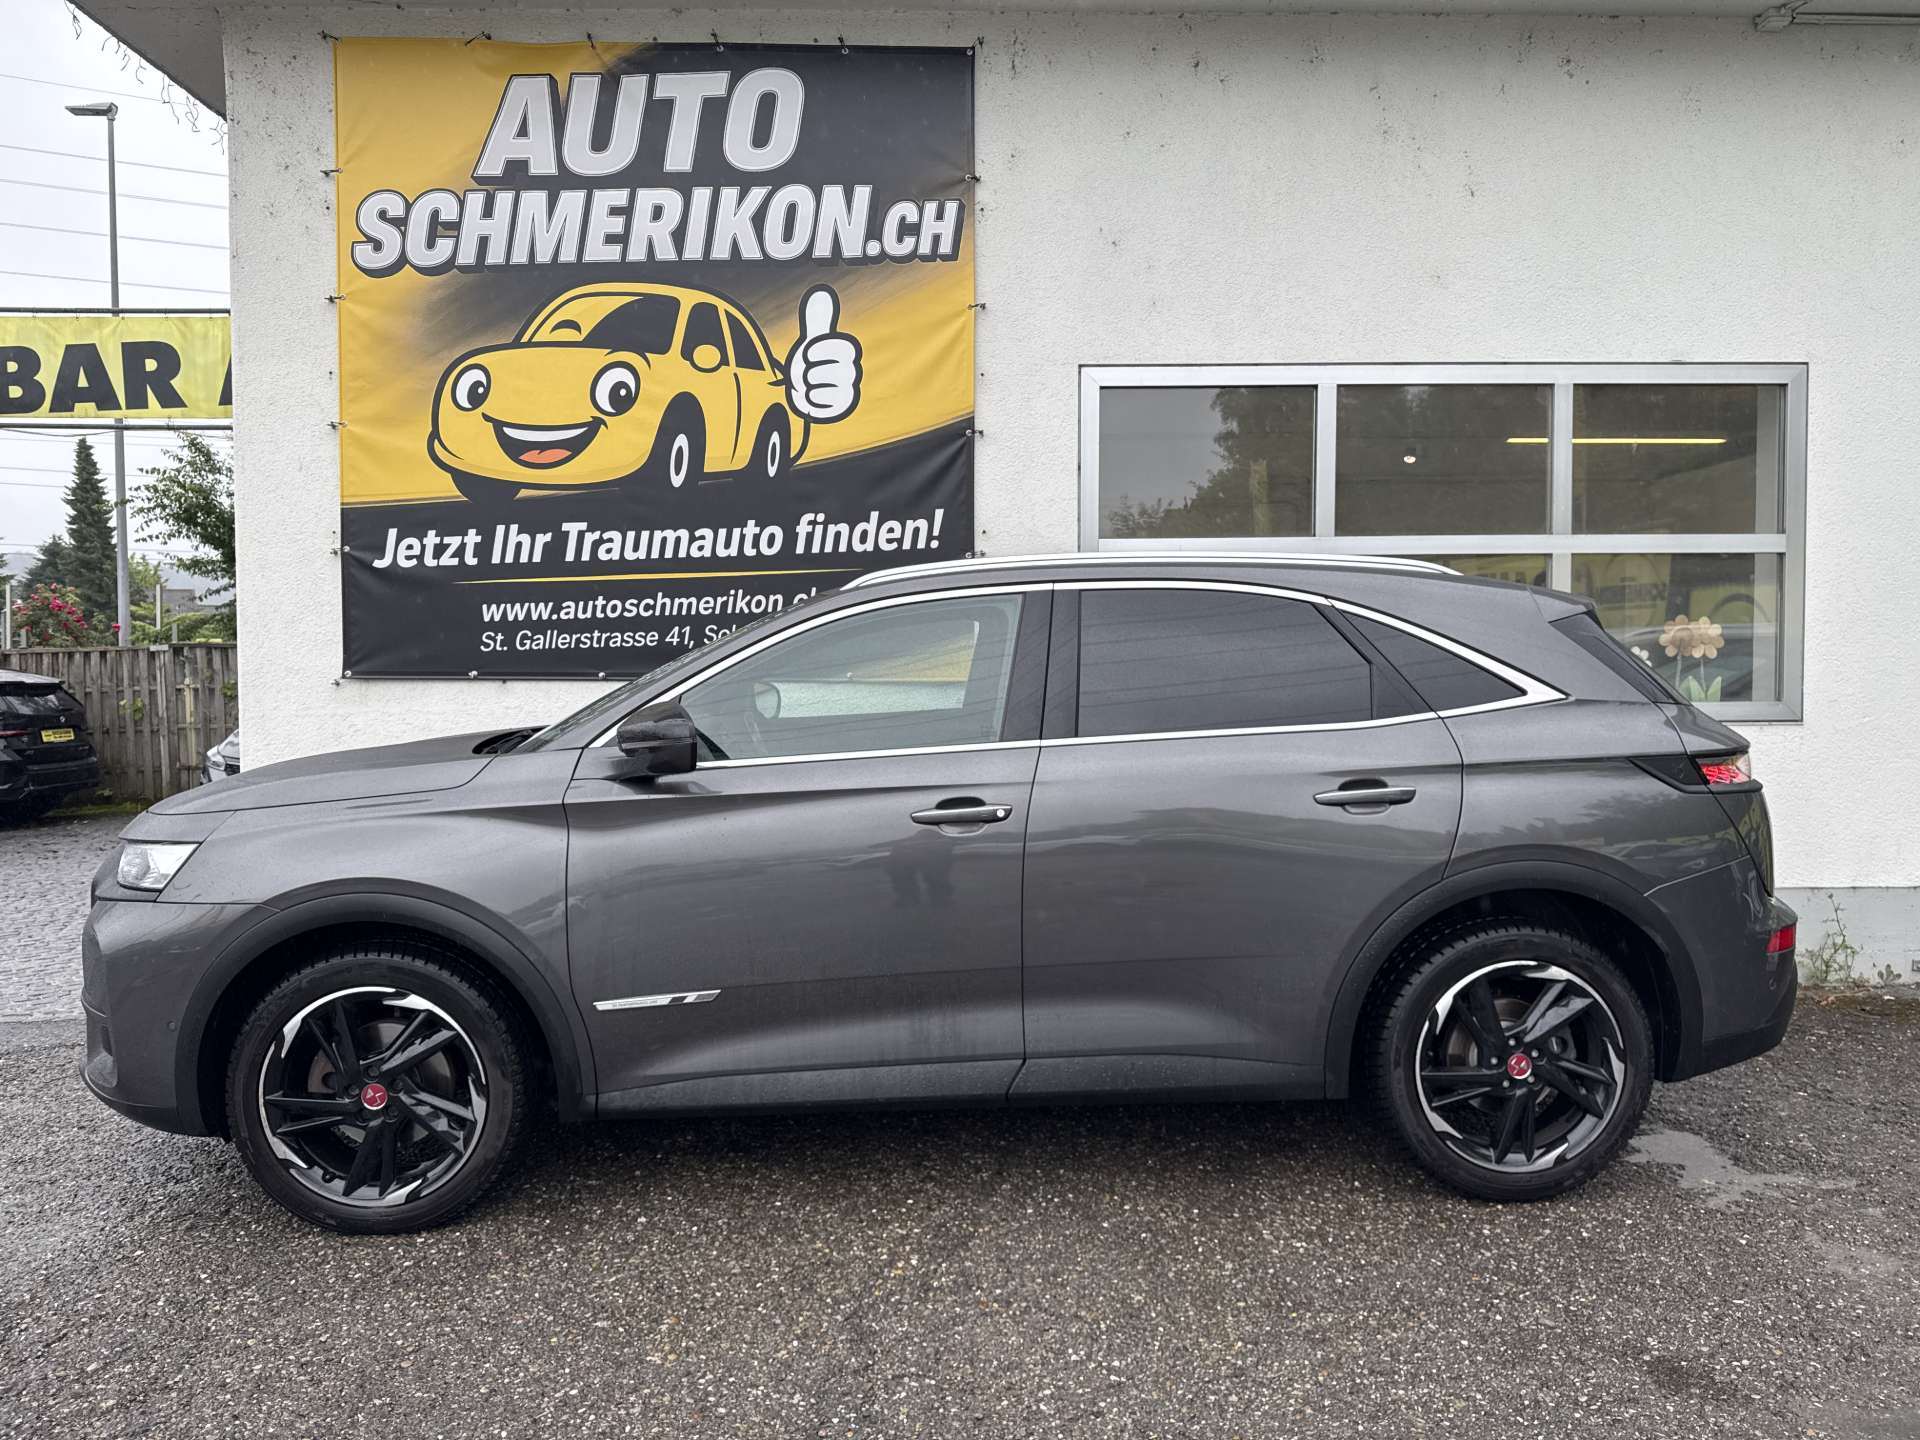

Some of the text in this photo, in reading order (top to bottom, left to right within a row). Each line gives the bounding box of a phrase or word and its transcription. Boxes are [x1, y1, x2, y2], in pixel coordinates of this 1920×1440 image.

[474, 67, 806, 177] AUTO
[352, 183, 960, 269] SCHMERIKON.CH
[0, 340, 189, 414] BAR
[372, 508, 945, 569] Jetzt Ihr Traumauto finden!
[481, 586, 817, 622] www.autoschmerikon
[480, 631, 508, 652] St.
[515, 629, 659, 651] Gallerstrasse
[665, 625, 695, 649] 41,
